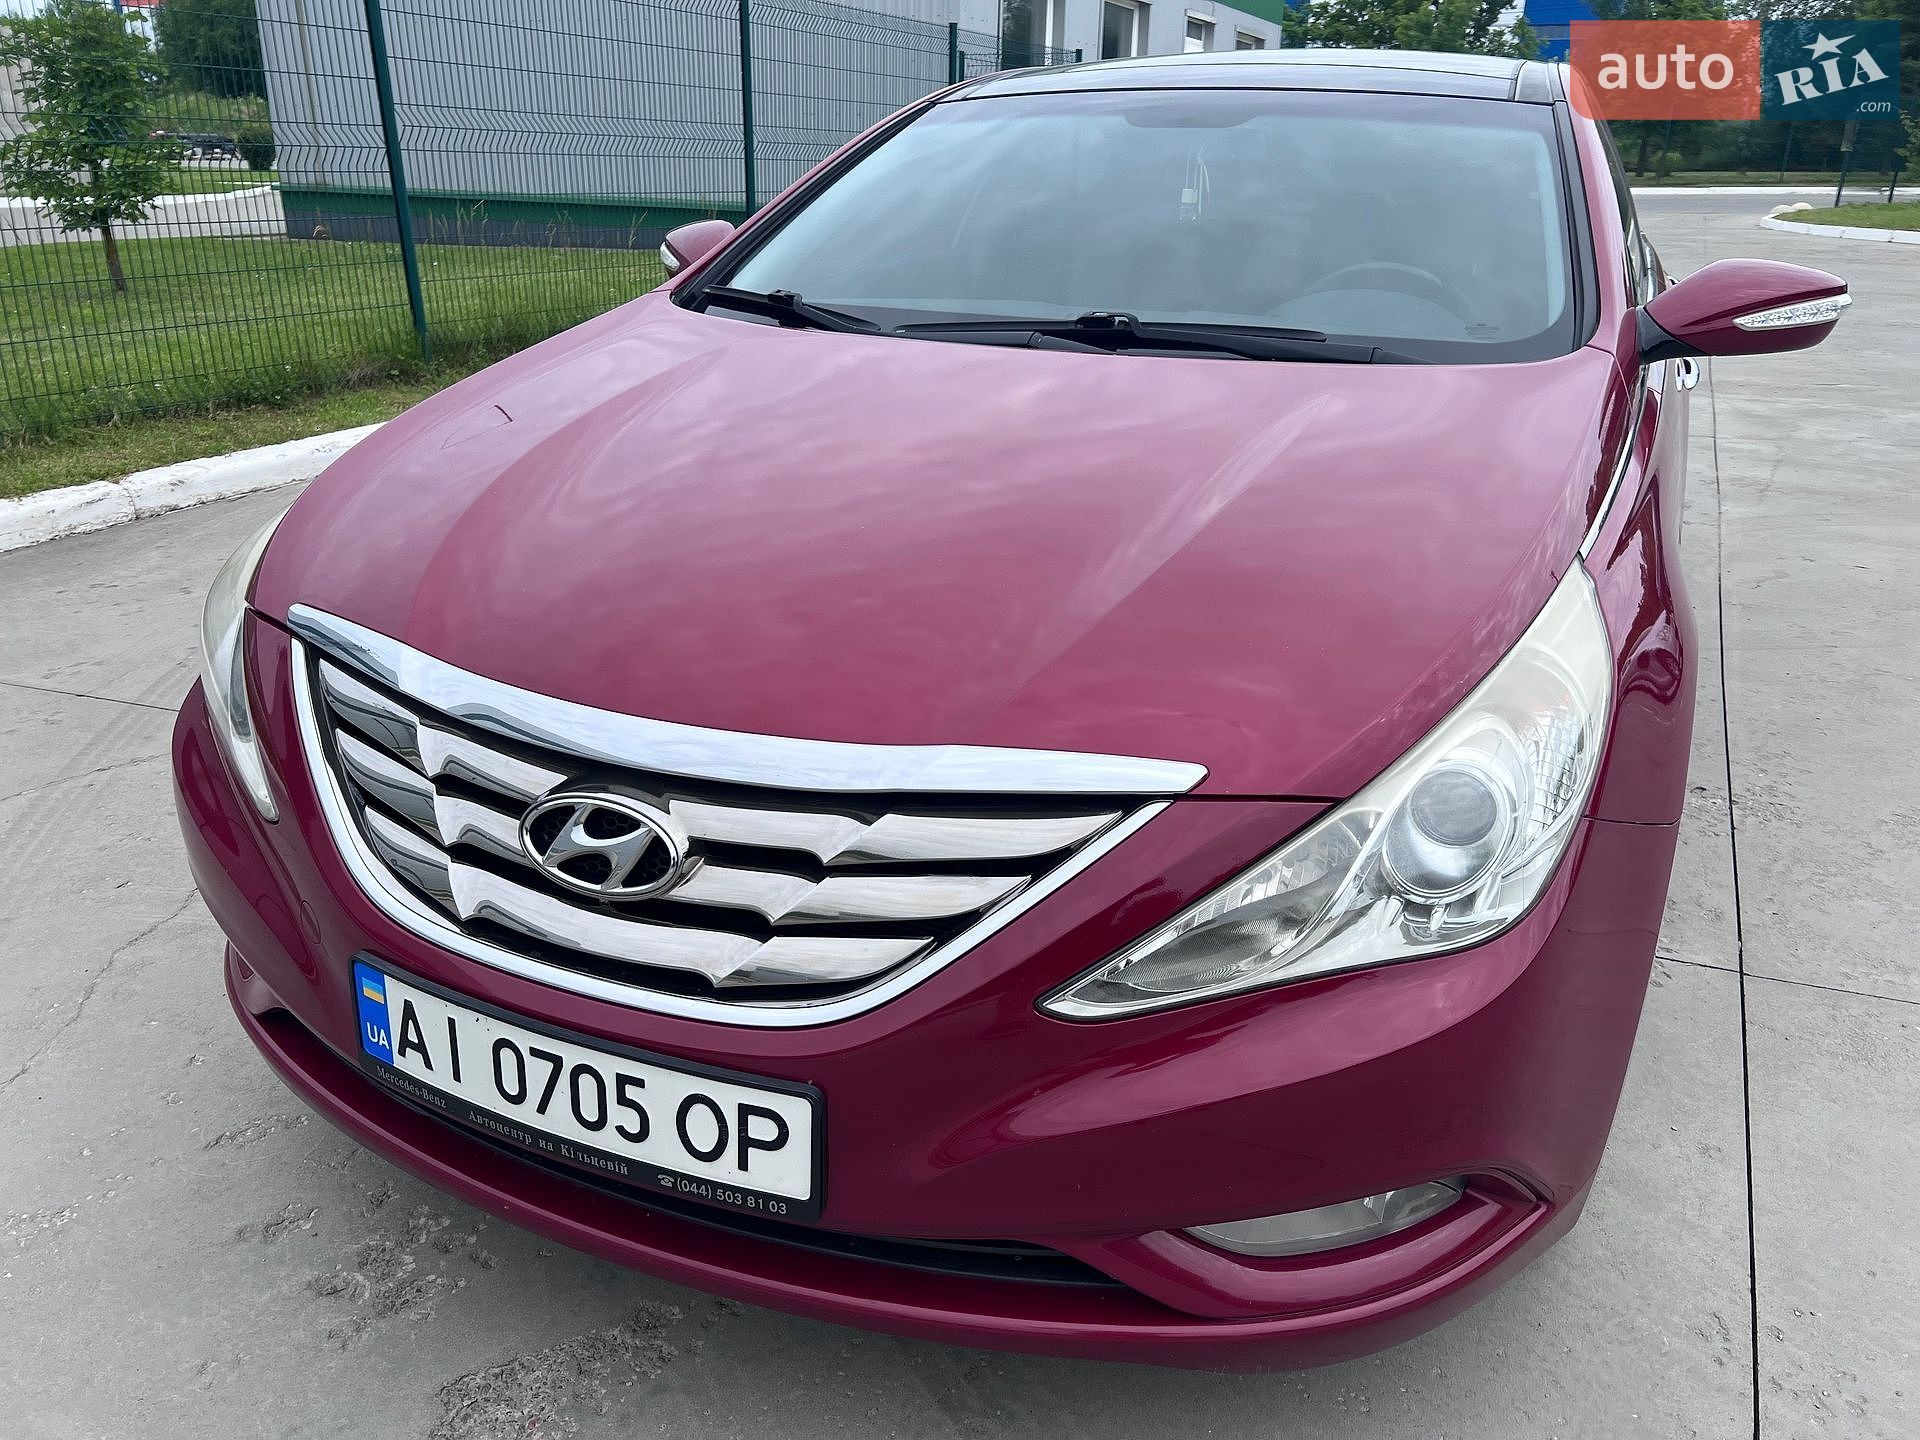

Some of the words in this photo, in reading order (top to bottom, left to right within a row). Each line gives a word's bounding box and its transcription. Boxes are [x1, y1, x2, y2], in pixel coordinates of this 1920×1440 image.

[366, 1021, 390, 1050] UA
[376, 1064, 447, 1109] Mercedes-Benz
[398, 998, 462, 1084] AI
[491, 1037, 650, 1143] 0705
[676, 1093, 790, 1172] OP
[468, 1110, 532, 1145] Автоцентр
[538, 1137, 554, 1151] на
[560, 1143, 629, 1176] Кільцевій
[677, 1177, 712, 1199] (044)
[716, 1189, 742, 1205] 503
[747, 1196, 763, 1210] 81
[769, 1200, 787, 1215] 03
